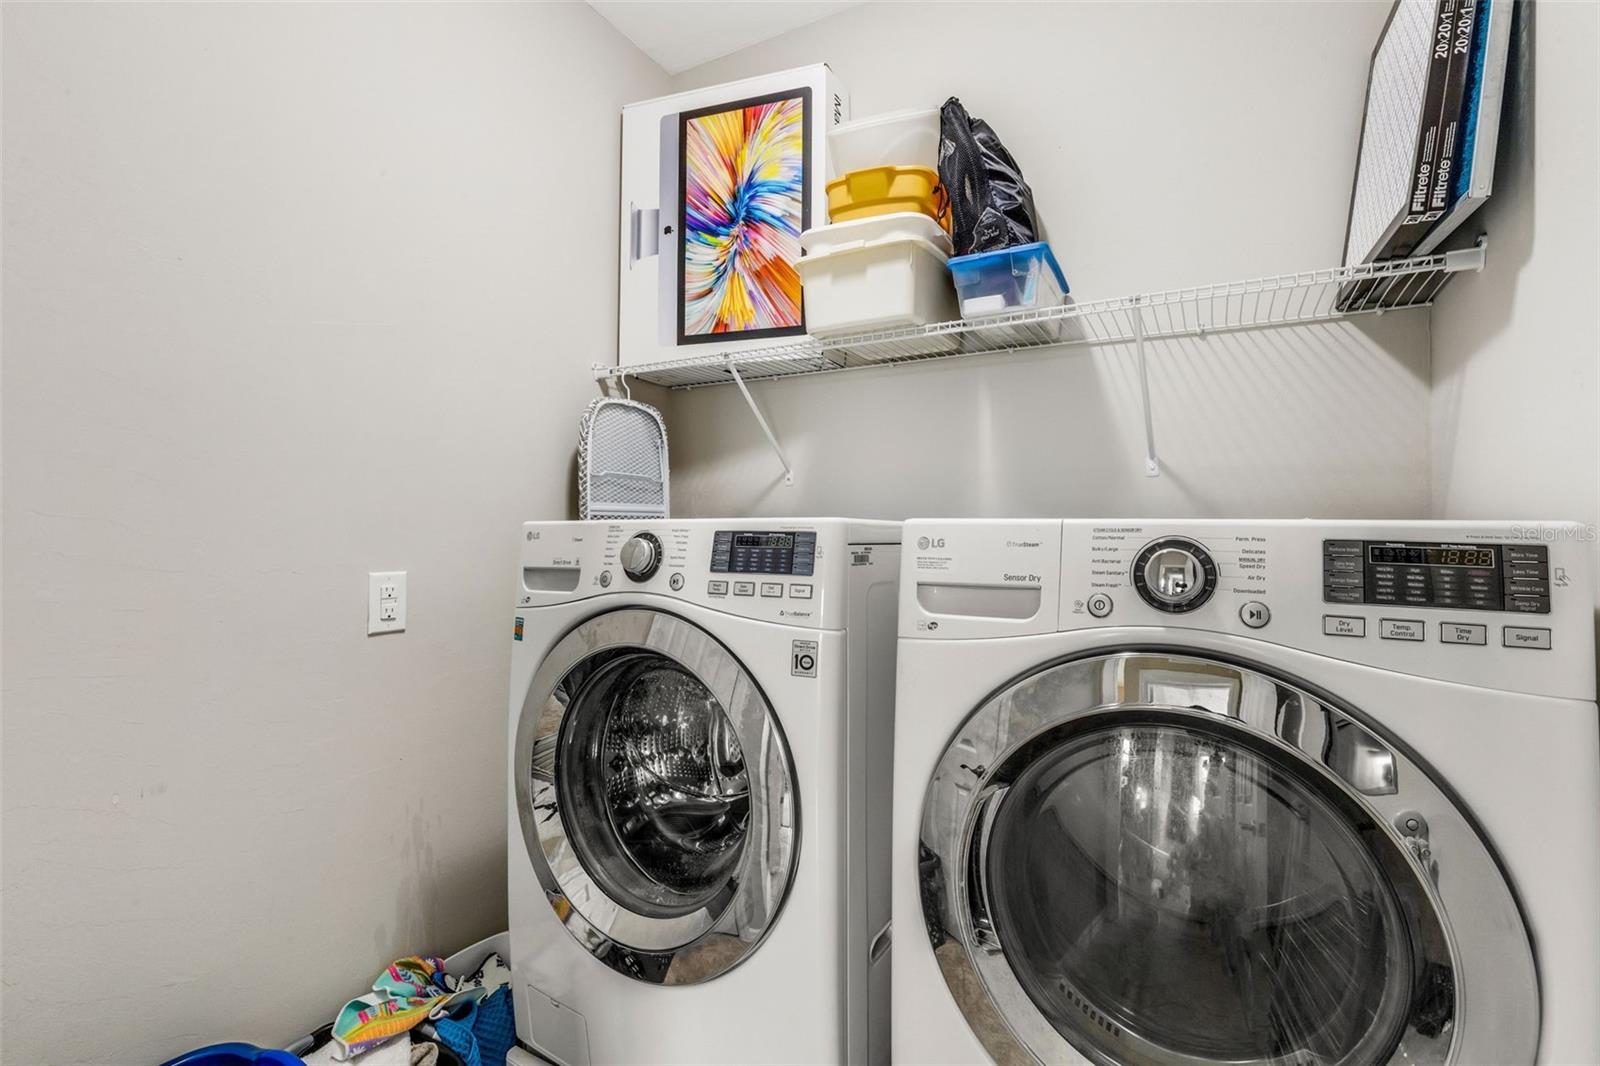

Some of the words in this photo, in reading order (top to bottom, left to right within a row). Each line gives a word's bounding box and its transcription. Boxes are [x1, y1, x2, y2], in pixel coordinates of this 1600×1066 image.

[1435, 12, 1453, 59] 20x20x1
[1454, 7, 1473, 54] 20x20x1
[833, 93, 842, 125] iMa
[1411, 164, 1431, 212] Filtrete
[1431, 159, 1451, 208] Filtrete
[1003, 573, 1026, 581] Sensor
[1028, 574, 1041, 583] Dry
[1390, 630, 1415, 638] Control
[1515, 634, 1539, 642] Signal
